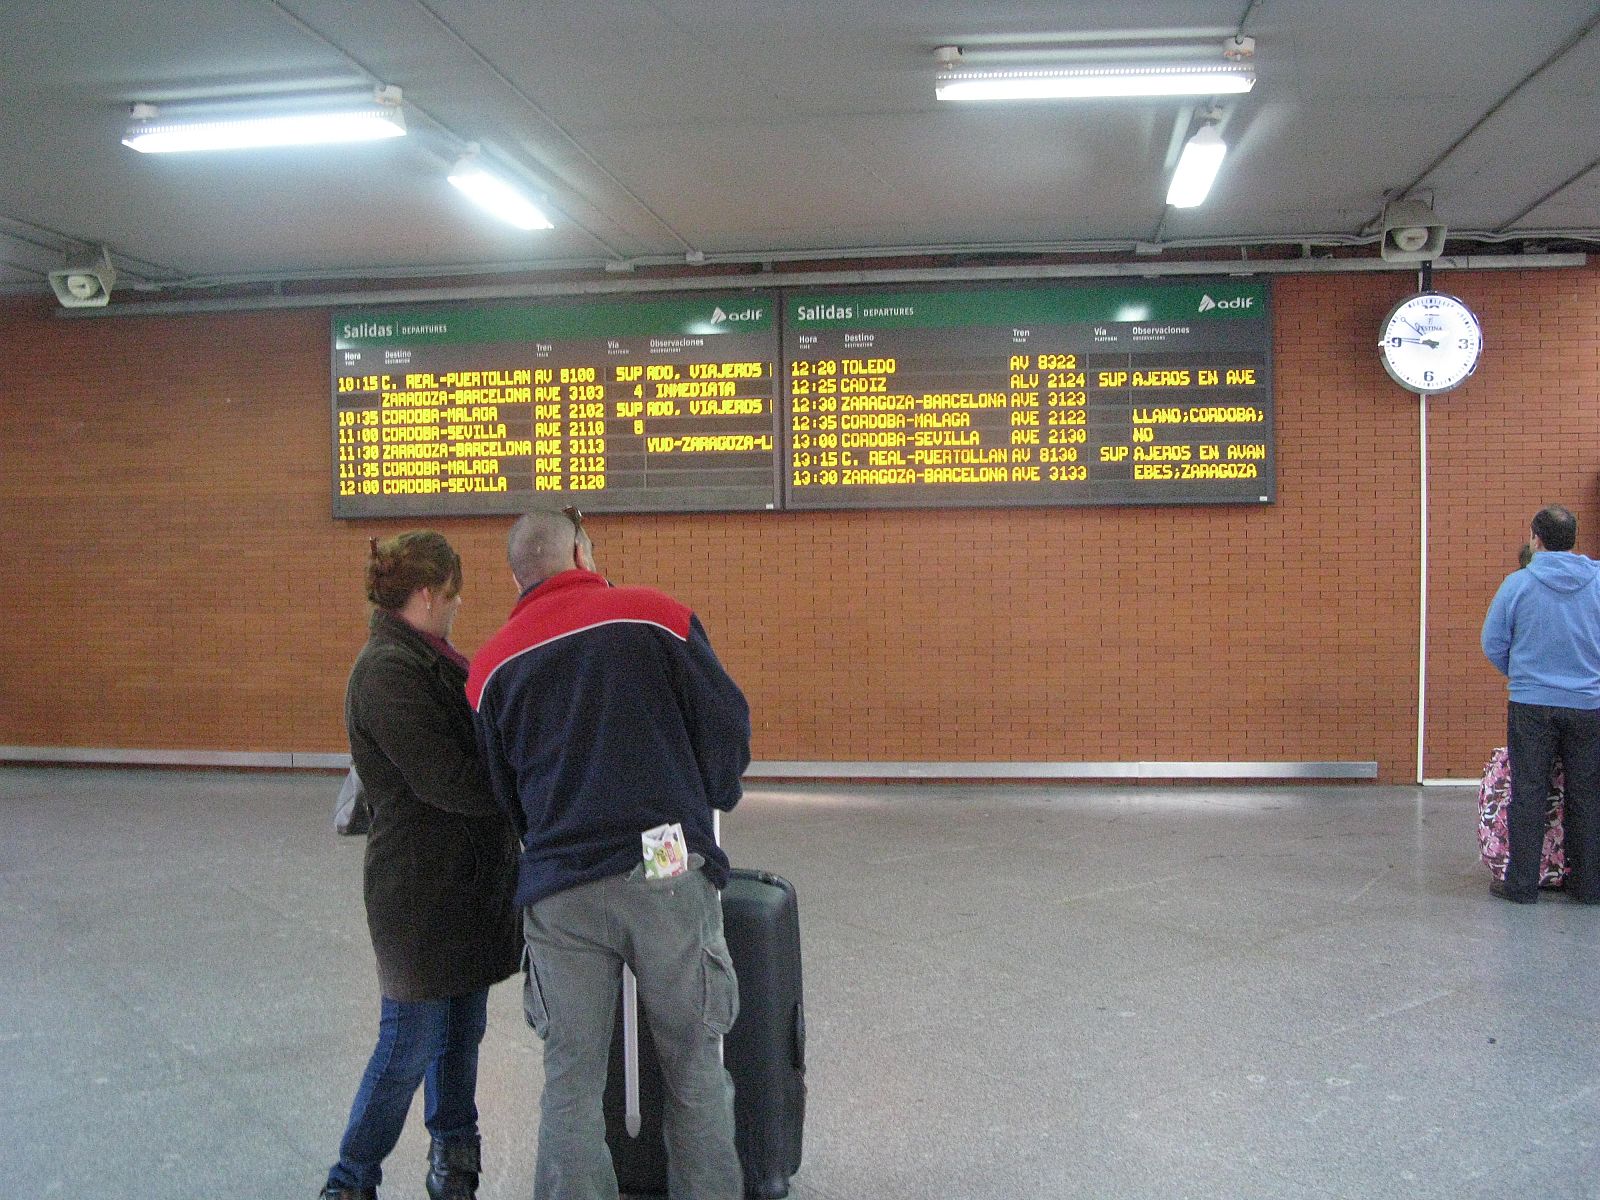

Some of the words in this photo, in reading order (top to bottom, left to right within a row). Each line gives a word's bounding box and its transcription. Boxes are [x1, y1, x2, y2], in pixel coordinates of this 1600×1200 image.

[1217, 297, 1253, 309] adif
[728, 309, 763, 321] adif
[797, 304, 853, 321] Salidas
[863, 307, 914, 317] DEPARTURES
[344, 323, 393, 338] Salidas
[402, 324, 447, 335] DEPARTURES
[844, 332, 875, 343] Destino
[1013, 328, 1030, 338] Tren
[1132, 326, 1190, 336] Observaciones
[537, 343, 552, 353] Tren
[650, 338, 704, 348] Observaciones
[799, 335, 818, 344] Hora
[1391, 337, 1402, 348] 9
[1458, 338, 1469, 350] 3
[344, 351, 361, 361] Hora
[385, 350, 412, 360] Destino
[792, 360, 837, 377] 12:20
[842, 359, 896, 375] TOLEDO
[1010, 355, 1030, 371] AV
[1038, 355, 1076, 370] 8322
[339, 376, 379, 392] 10:15
[381, 375, 397, 390] C.
[405, 369, 531, 389] REAL-PUERTOLLAN
[535, 369, 553, 385] AV
[560, 368, 596, 384] 8100
[616, 366, 643, 382] SUP
[689, 363, 762, 379] VIAJEROS
[792, 378, 837, 395] 12:25
[841, 377, 887, 393] CADIZ
[1010, 374, 1039, 389] ALV
[1047, 373, 1086, 388] 2124
[1099, 372, 1128, 388] SUP
[1132, 371, 1191, 387] AJEROS
[1199, 370, 1219, 385] EN
[1226, 369, 1256, 385] AVE
[1423, 370, 1434, 382] 6
[382, 387, 531, 407] ZARAGOZA-BARCELONA
[535, 387, 561, 403] AVE
[568, 385, 605, 401] 3103
[633, 384, 643, 399] 4
[793, 396, 837, 413] 12:30
[841, 393, 1007, 411] ZARAGOZA-BARCELONA
[1011, 392, 1040, 408] AVE
[1048, 391, 1086, 407] 3123
[339, 410, 379, 427] 10:35
[382, 406, 498, 425] CORDOBA-MALAGA
[535, 404, 562, 420] AVE
[569, 403, 605, 419] 2102
[616, 401, 643, 417] SUP
[689, 399, 763, 416] VIAJEROS
[793, 415, 838, 431] 12:35
[841, 412, 970, 430] CORDOBA-MALAGA
[1011, 411, 1040, 426] AVE
[1048, 410, 1086, 425] 2122
[1132, 407, 1264, 424] LLANO;CORDOBA;
[339, 427, 379, 444] 11:00
[382, 424, 507, 442] CORDOBA-SEVILLA
[536, 422, 562, 438] AVE
[569, 421, 605, 437] 2110
[633, 420, 644, 435] 8
[793, 433, 838, 449] 13:00
[842, 431, 980, 448] CORDOBA-SEVILLA
[1011, 429, 1040, 445] AVE
[1048, 429, 1087, 444] 2130
[1133, 427, 1154, 442] NO
[340, 445, 379, 461] 11:30
[382, 440, 532, 460] ZARAGOZA-BARCELONA
[536, 440, 562, 456] AVE
[569, 439, 605, 455] 3113
[793, 451, 838, 468] 13:15
[842, 451, 859, 466] C.
[869, 448, 1008, 466] REAL-PUERTOLLAN
[1012, 448, 1031, 463] AV
[1039, 447, 1078, 463] 8130
[1100, 447, 1129, 462] SUP
[1133, 446, 1192, 461] AJEROS
[1200, 445, 1220, 460] EN
[1228, 444, 1266, 460] AVAN
[340, 462, 379, 478] 11:35
[382, 459, 499, 477] CORDOBA-MALAGA
[536, 458, 562, 473] AVE
[570, 457, 605, 473] 2112
[794, 470, 839, 486] 13:30
[842, 466, 1008, 485] ZARAGOZA-BARCELONA
[1012, 466, 1041, 482] AVE
[1049, 465, 1087, 481] 3133
[1134, 464, 1258, 480] EBES;ZARAGOZA
[340, 478, 380, 495] 12:00
[382, 477, 507, 495] CORDOBA-SEVILLA
[536, 475, 562, 491] AVE
[570, 474, 605, 490] 2120
